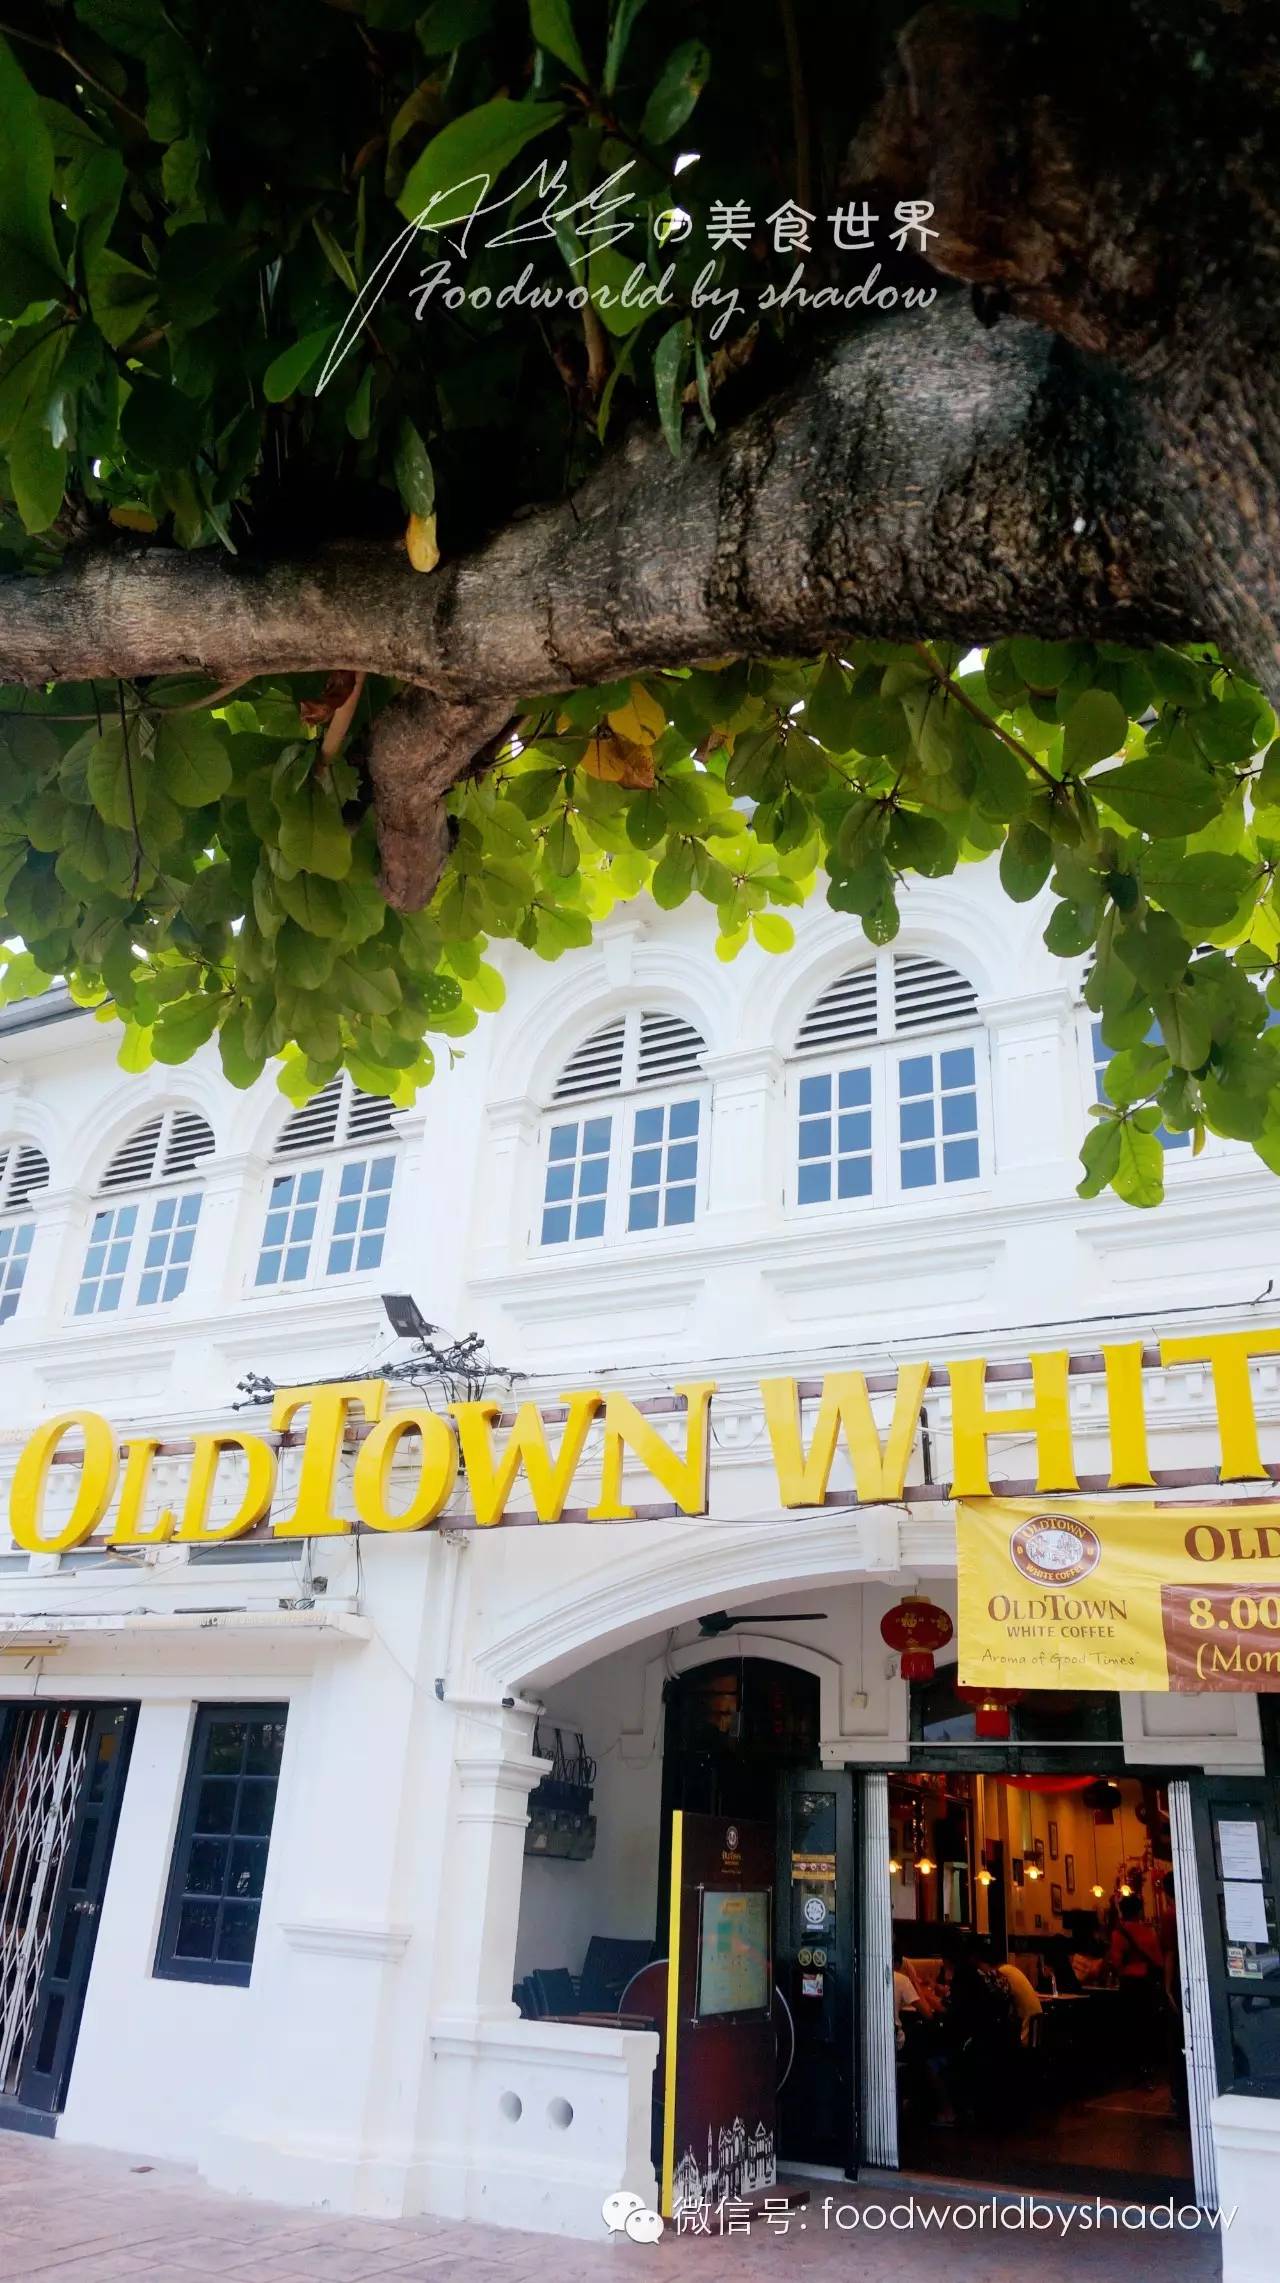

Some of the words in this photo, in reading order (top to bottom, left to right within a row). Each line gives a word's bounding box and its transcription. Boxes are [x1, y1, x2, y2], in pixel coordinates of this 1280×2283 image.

[1022, 1517, 1087, 1540] OLDTOWN
[1026, 1563, 1054, 1580] WHITE
[988, 1594, 1128, 1622] OLDTOWN
[1189, 1596, 1280, 1630] 8.00
[1007, 1625, 1055, 1638] WHITE
[1060, 1625, 1116, 1639] COFFEE
[981, 1648, 1026, 1663] Aroma
[1031, 1651, 1046, 1665] of
[1050, 1652, 1087, 1670] Good
